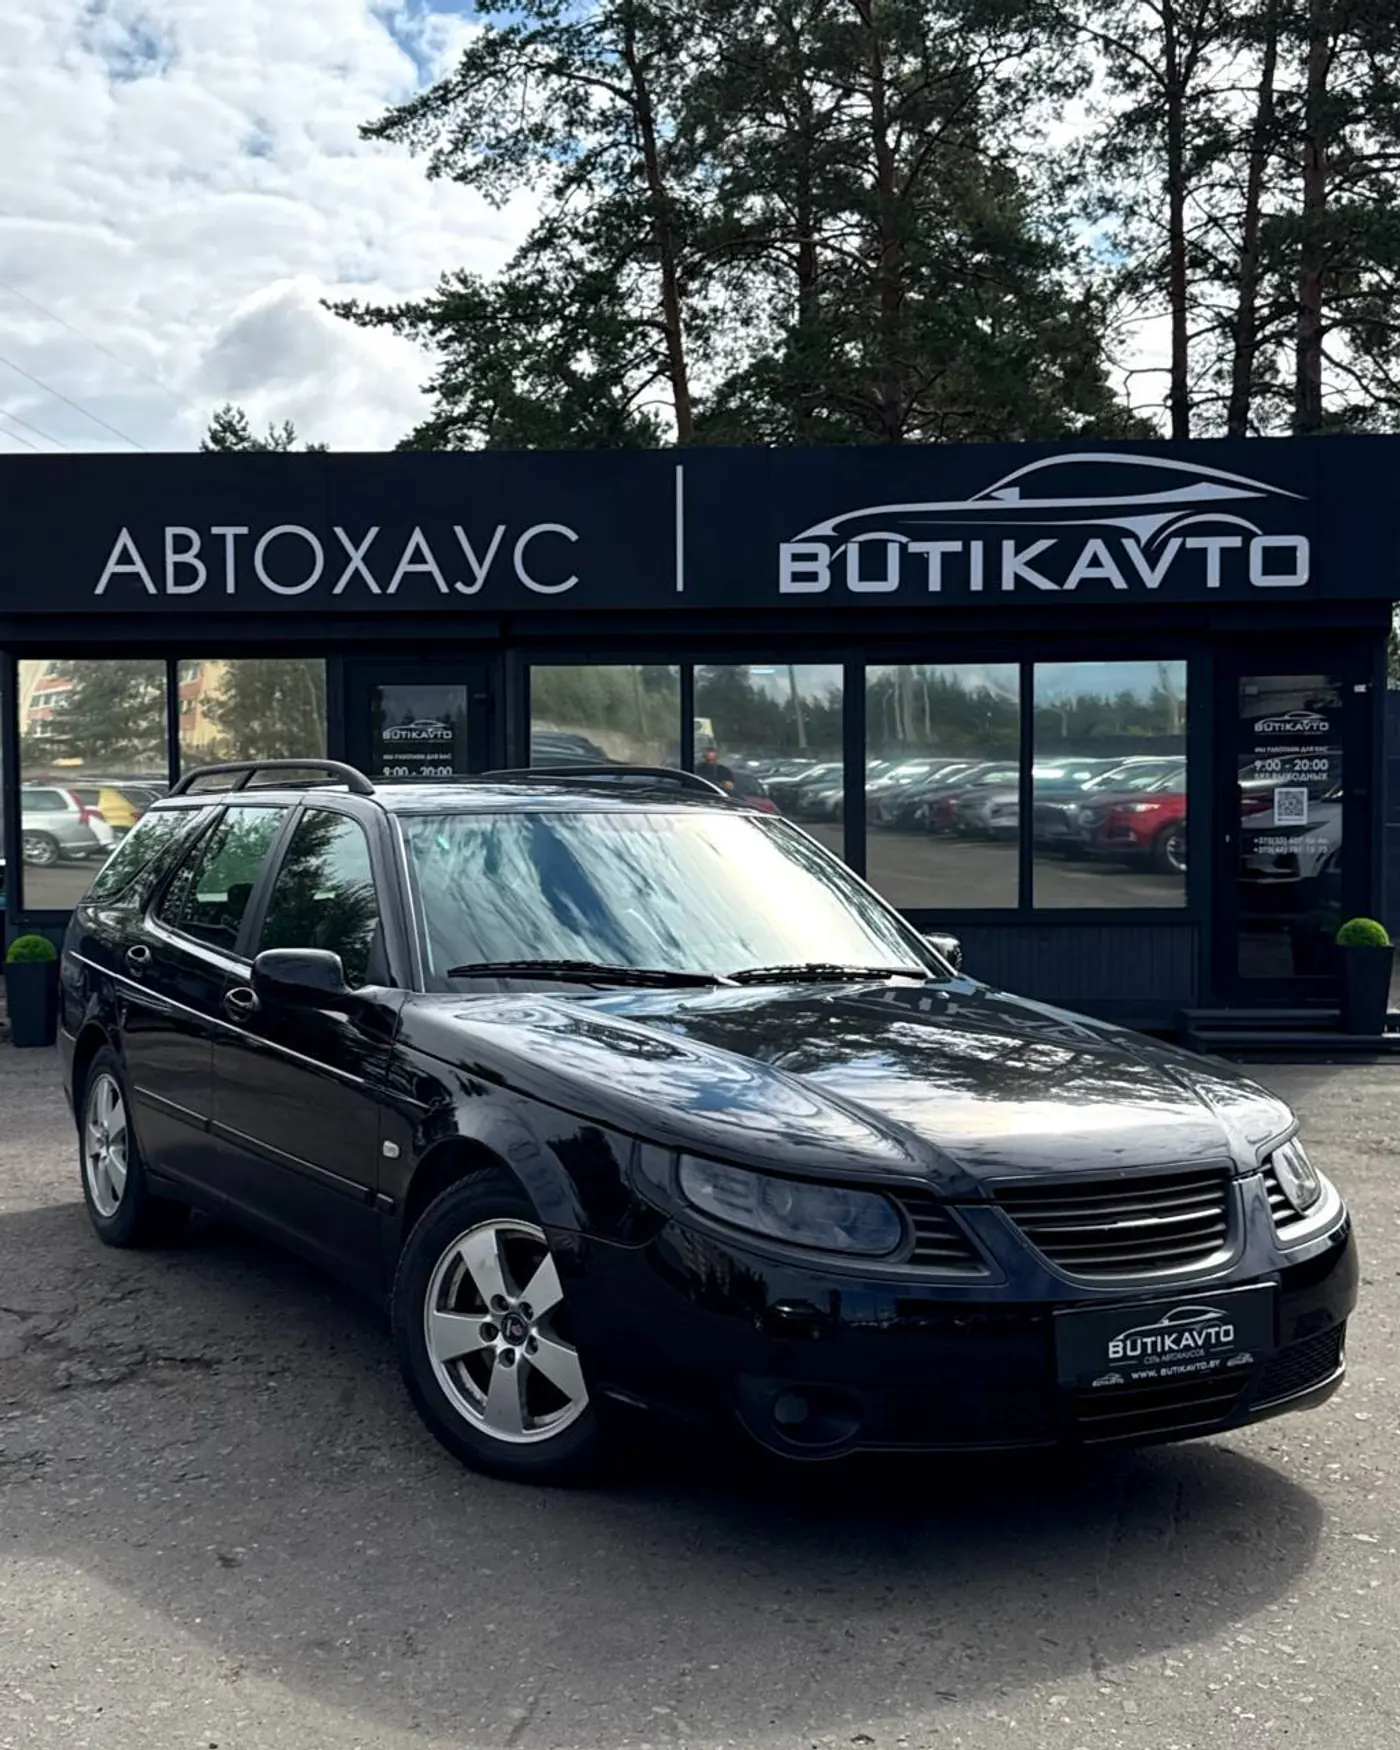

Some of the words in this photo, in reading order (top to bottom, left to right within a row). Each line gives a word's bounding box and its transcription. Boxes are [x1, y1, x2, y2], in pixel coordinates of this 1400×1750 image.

[94, 524, 580, 596] АВТОХАУС
[778, 534, 1311, 594] BUTIKAVTO
[382, 730, 453, 740] BUTIKAVTO
[1254, 721, 1330, 732] BUTIKAVTO
[1254, 759, 1281, 771] 9:00
[1293, 759, 1329, 771] 20:00
[1108, 1324, 1235, 1360] BUTIKAVTO
